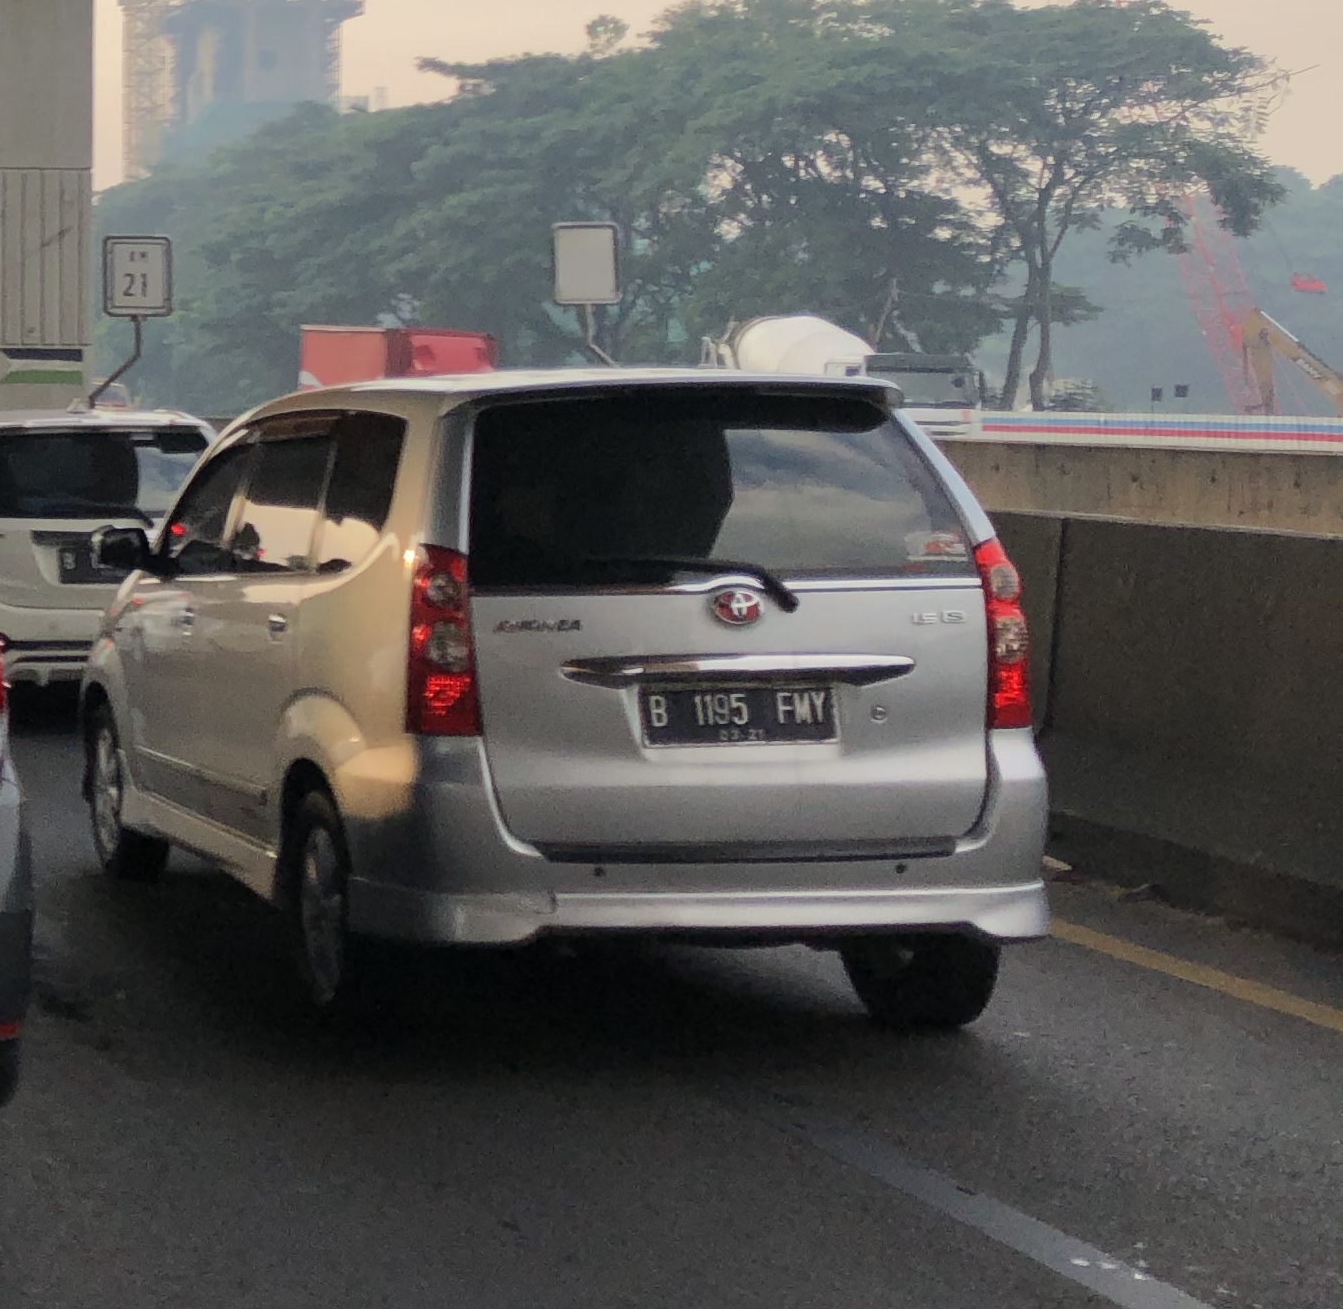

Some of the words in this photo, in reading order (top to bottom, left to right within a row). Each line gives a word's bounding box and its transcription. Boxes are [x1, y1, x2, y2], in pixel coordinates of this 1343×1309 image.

[122, 272, 148, 297] 21
[648, 694, 669, 727] B
[694, 693, 749, 726] 1195
[776, 690, 826, 725] FMY
